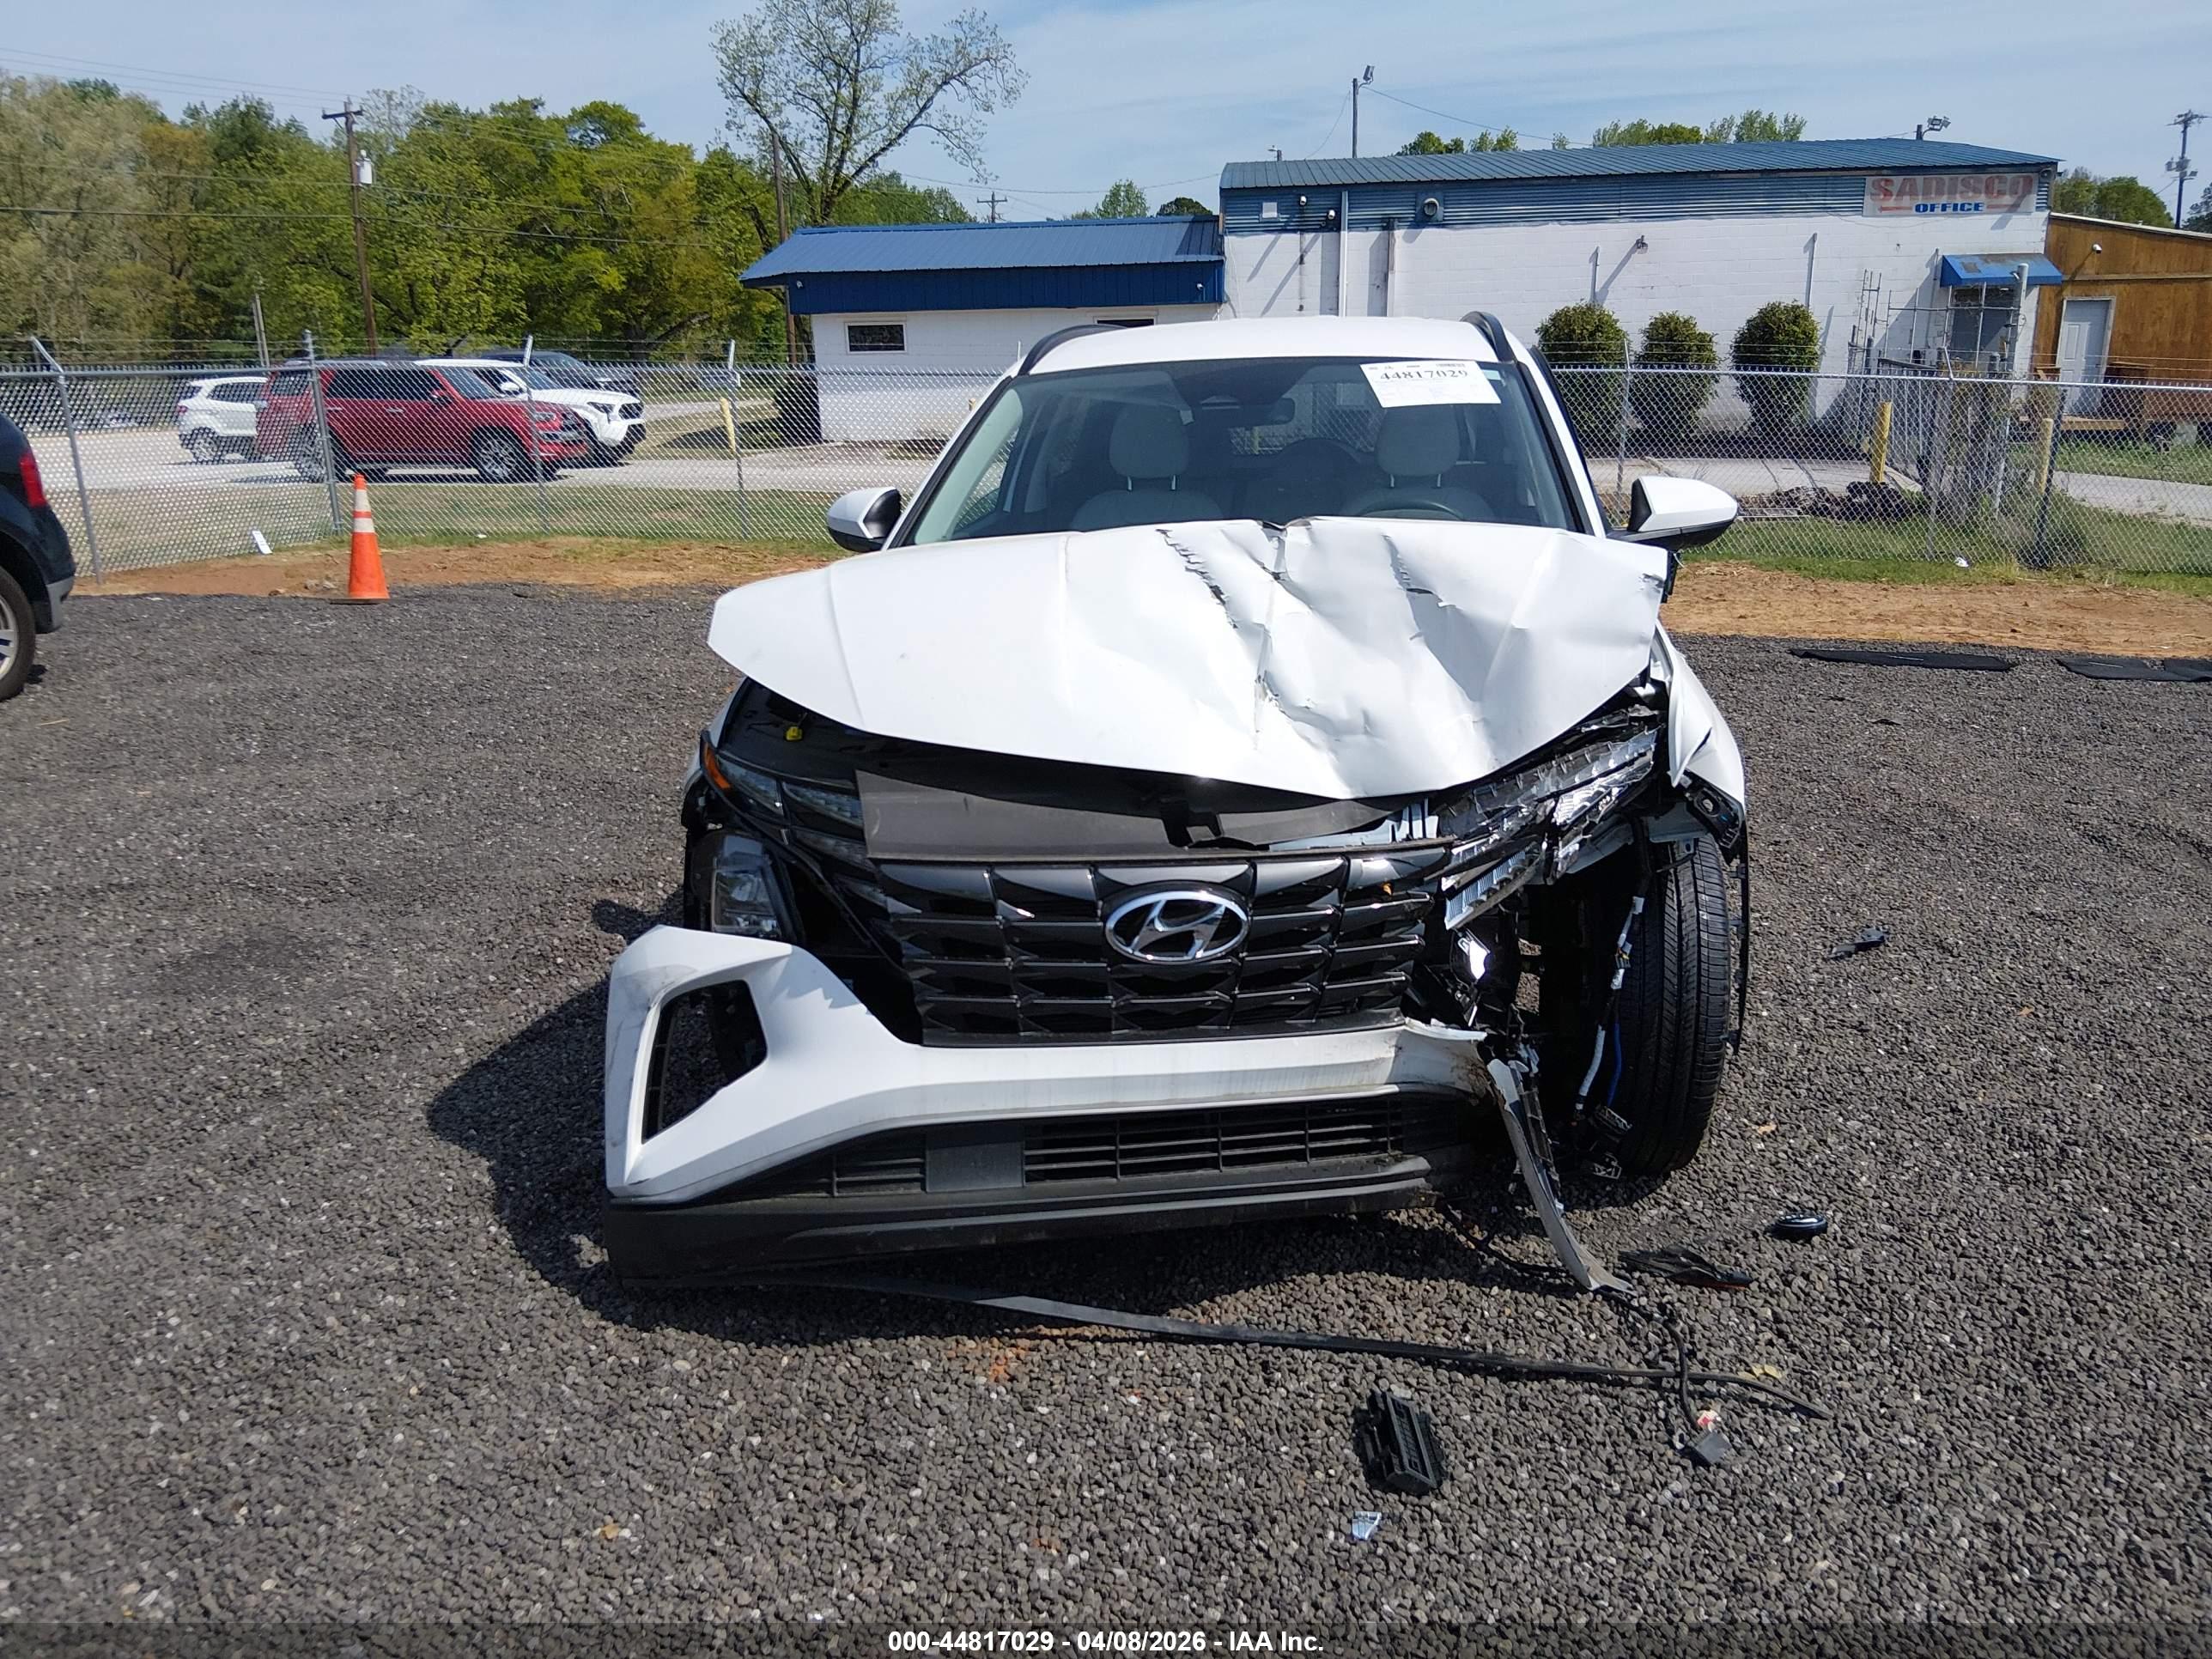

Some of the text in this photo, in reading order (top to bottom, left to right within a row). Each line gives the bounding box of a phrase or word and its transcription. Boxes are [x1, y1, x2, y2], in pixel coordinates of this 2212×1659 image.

[1870, 174, 2033, 202] SADISCO
[1915, 202, 1984, 213] OFFICE
[1380, 369, 1468, 380] 44817029
